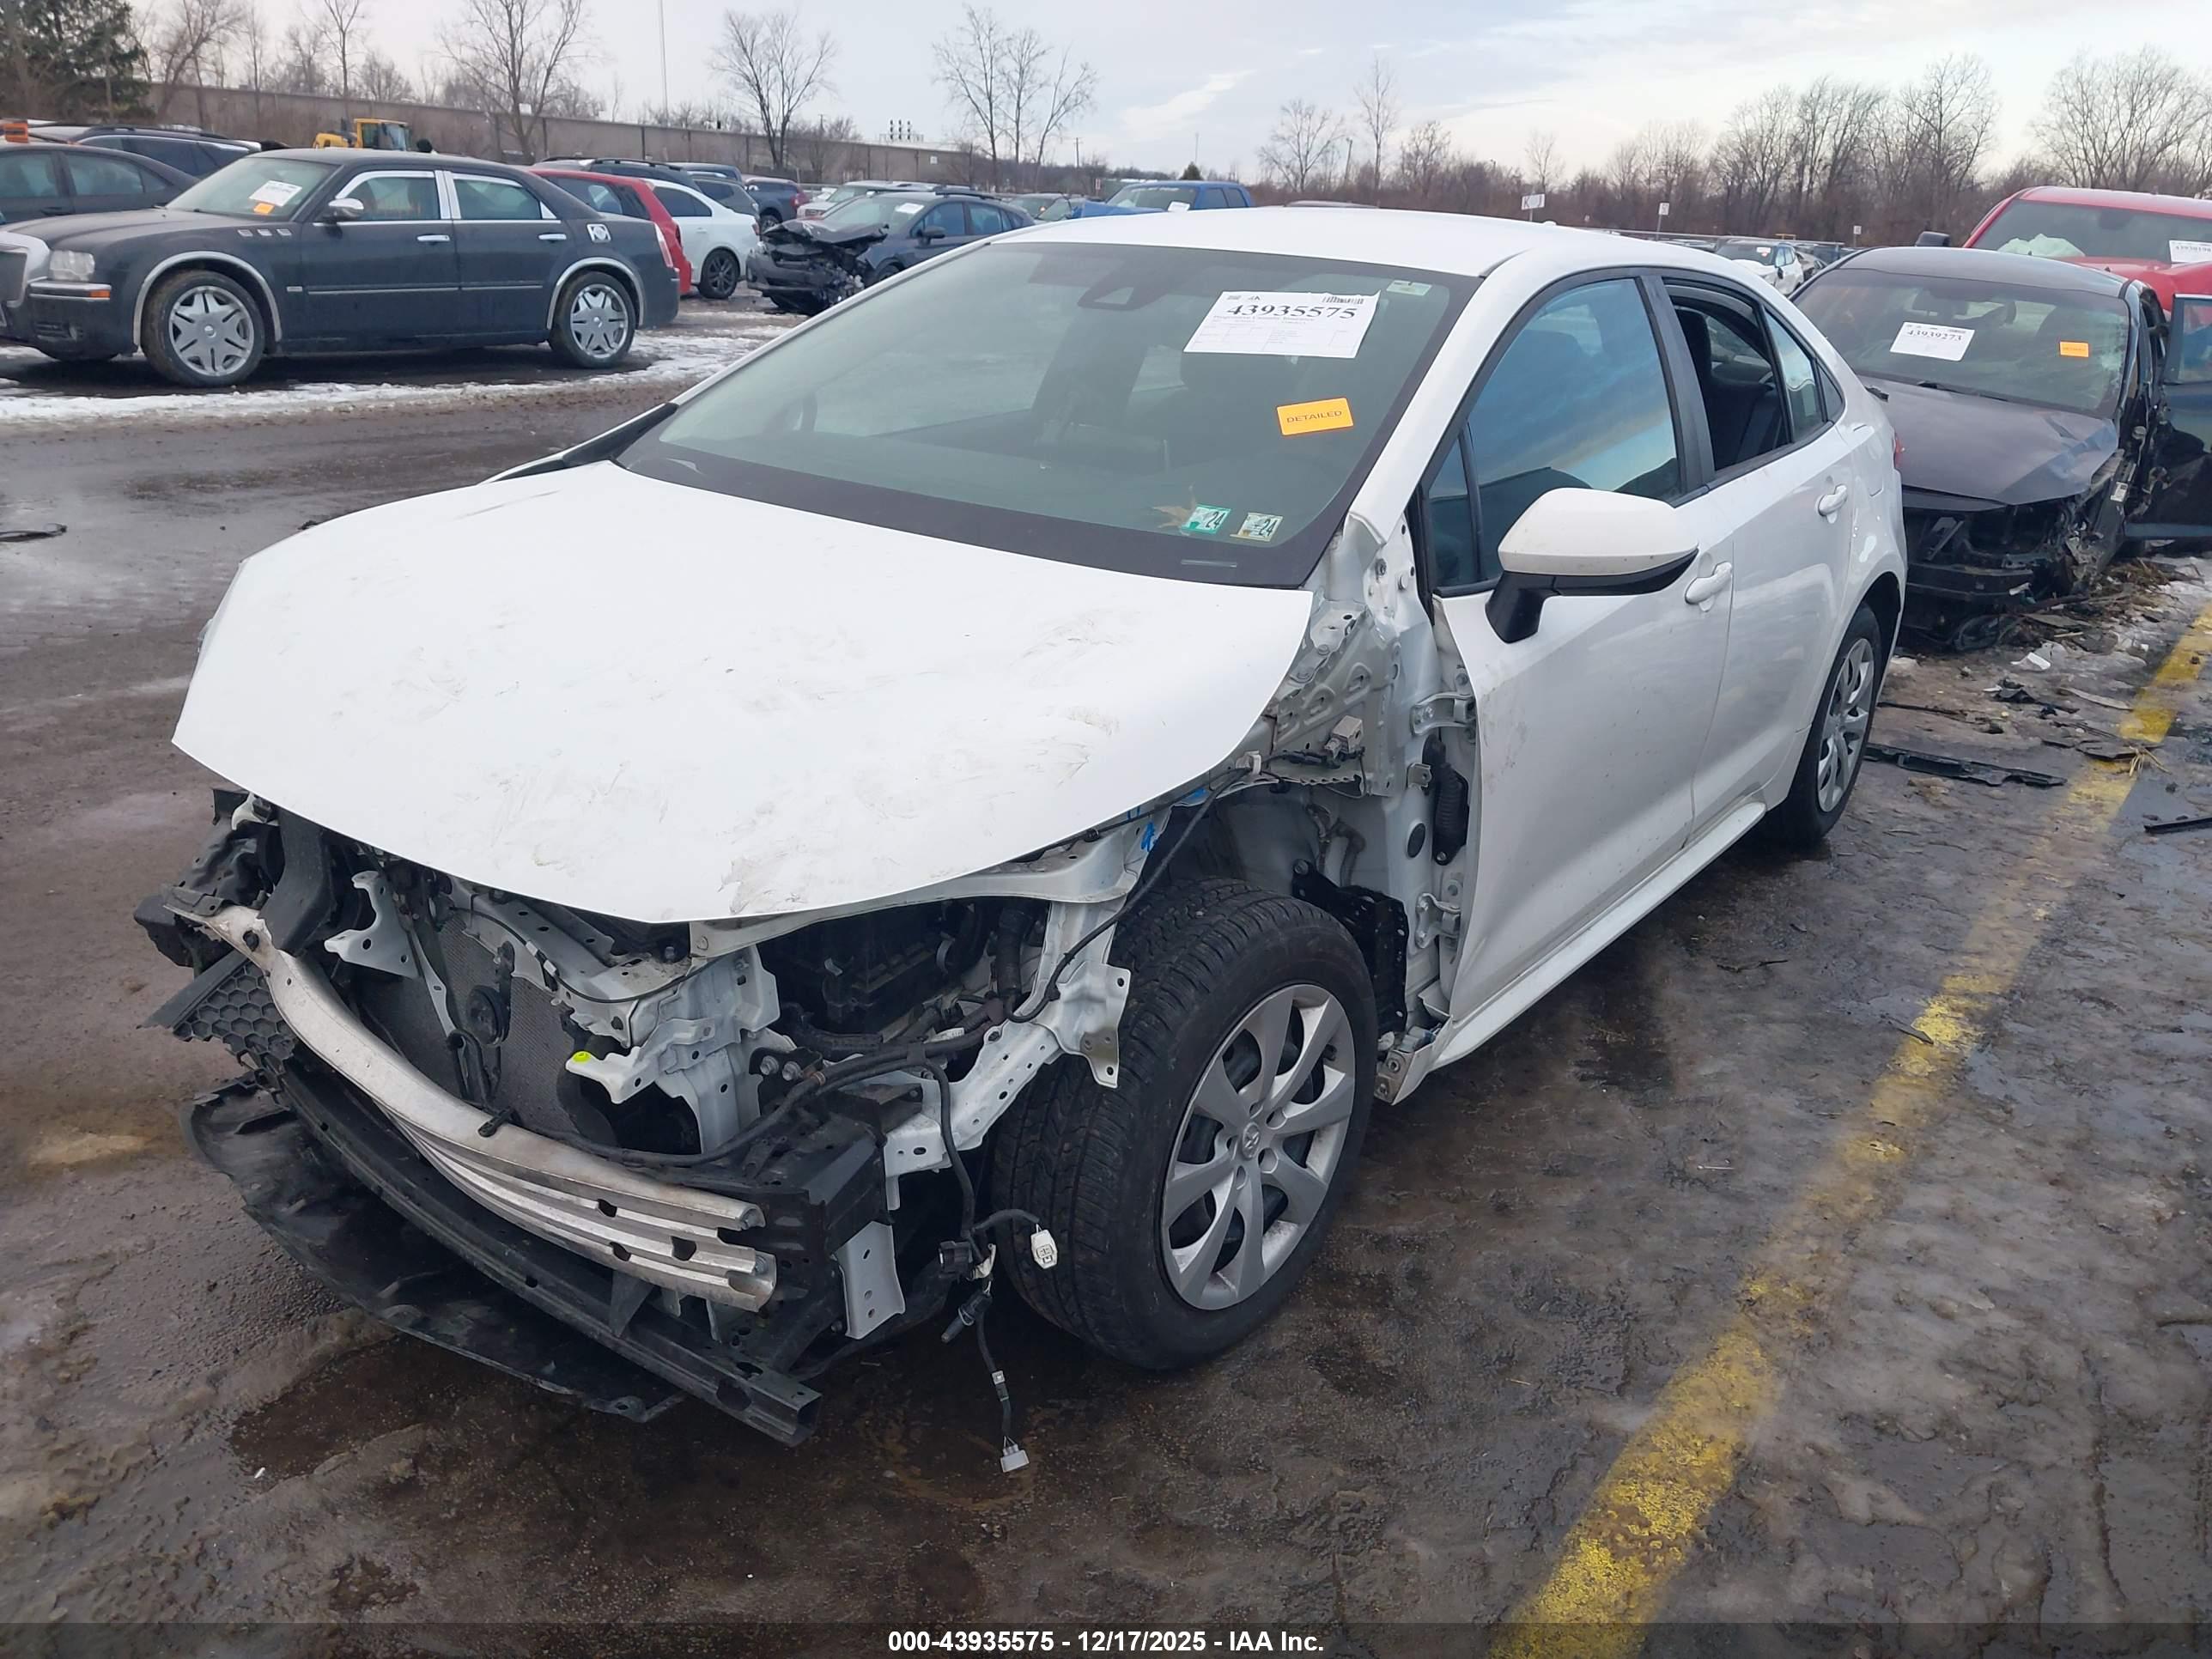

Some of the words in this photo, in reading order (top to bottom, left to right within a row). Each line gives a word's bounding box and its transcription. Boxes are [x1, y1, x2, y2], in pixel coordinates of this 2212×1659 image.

[1226, 303, 1358, 320] 43935575
[1906, 329, 1963, 342] 43939273
[1286, 410, 1343, 424] DETAILED
[1206, 511, 1226, 530] 24
[1258, 518, 1278, 538] 24
